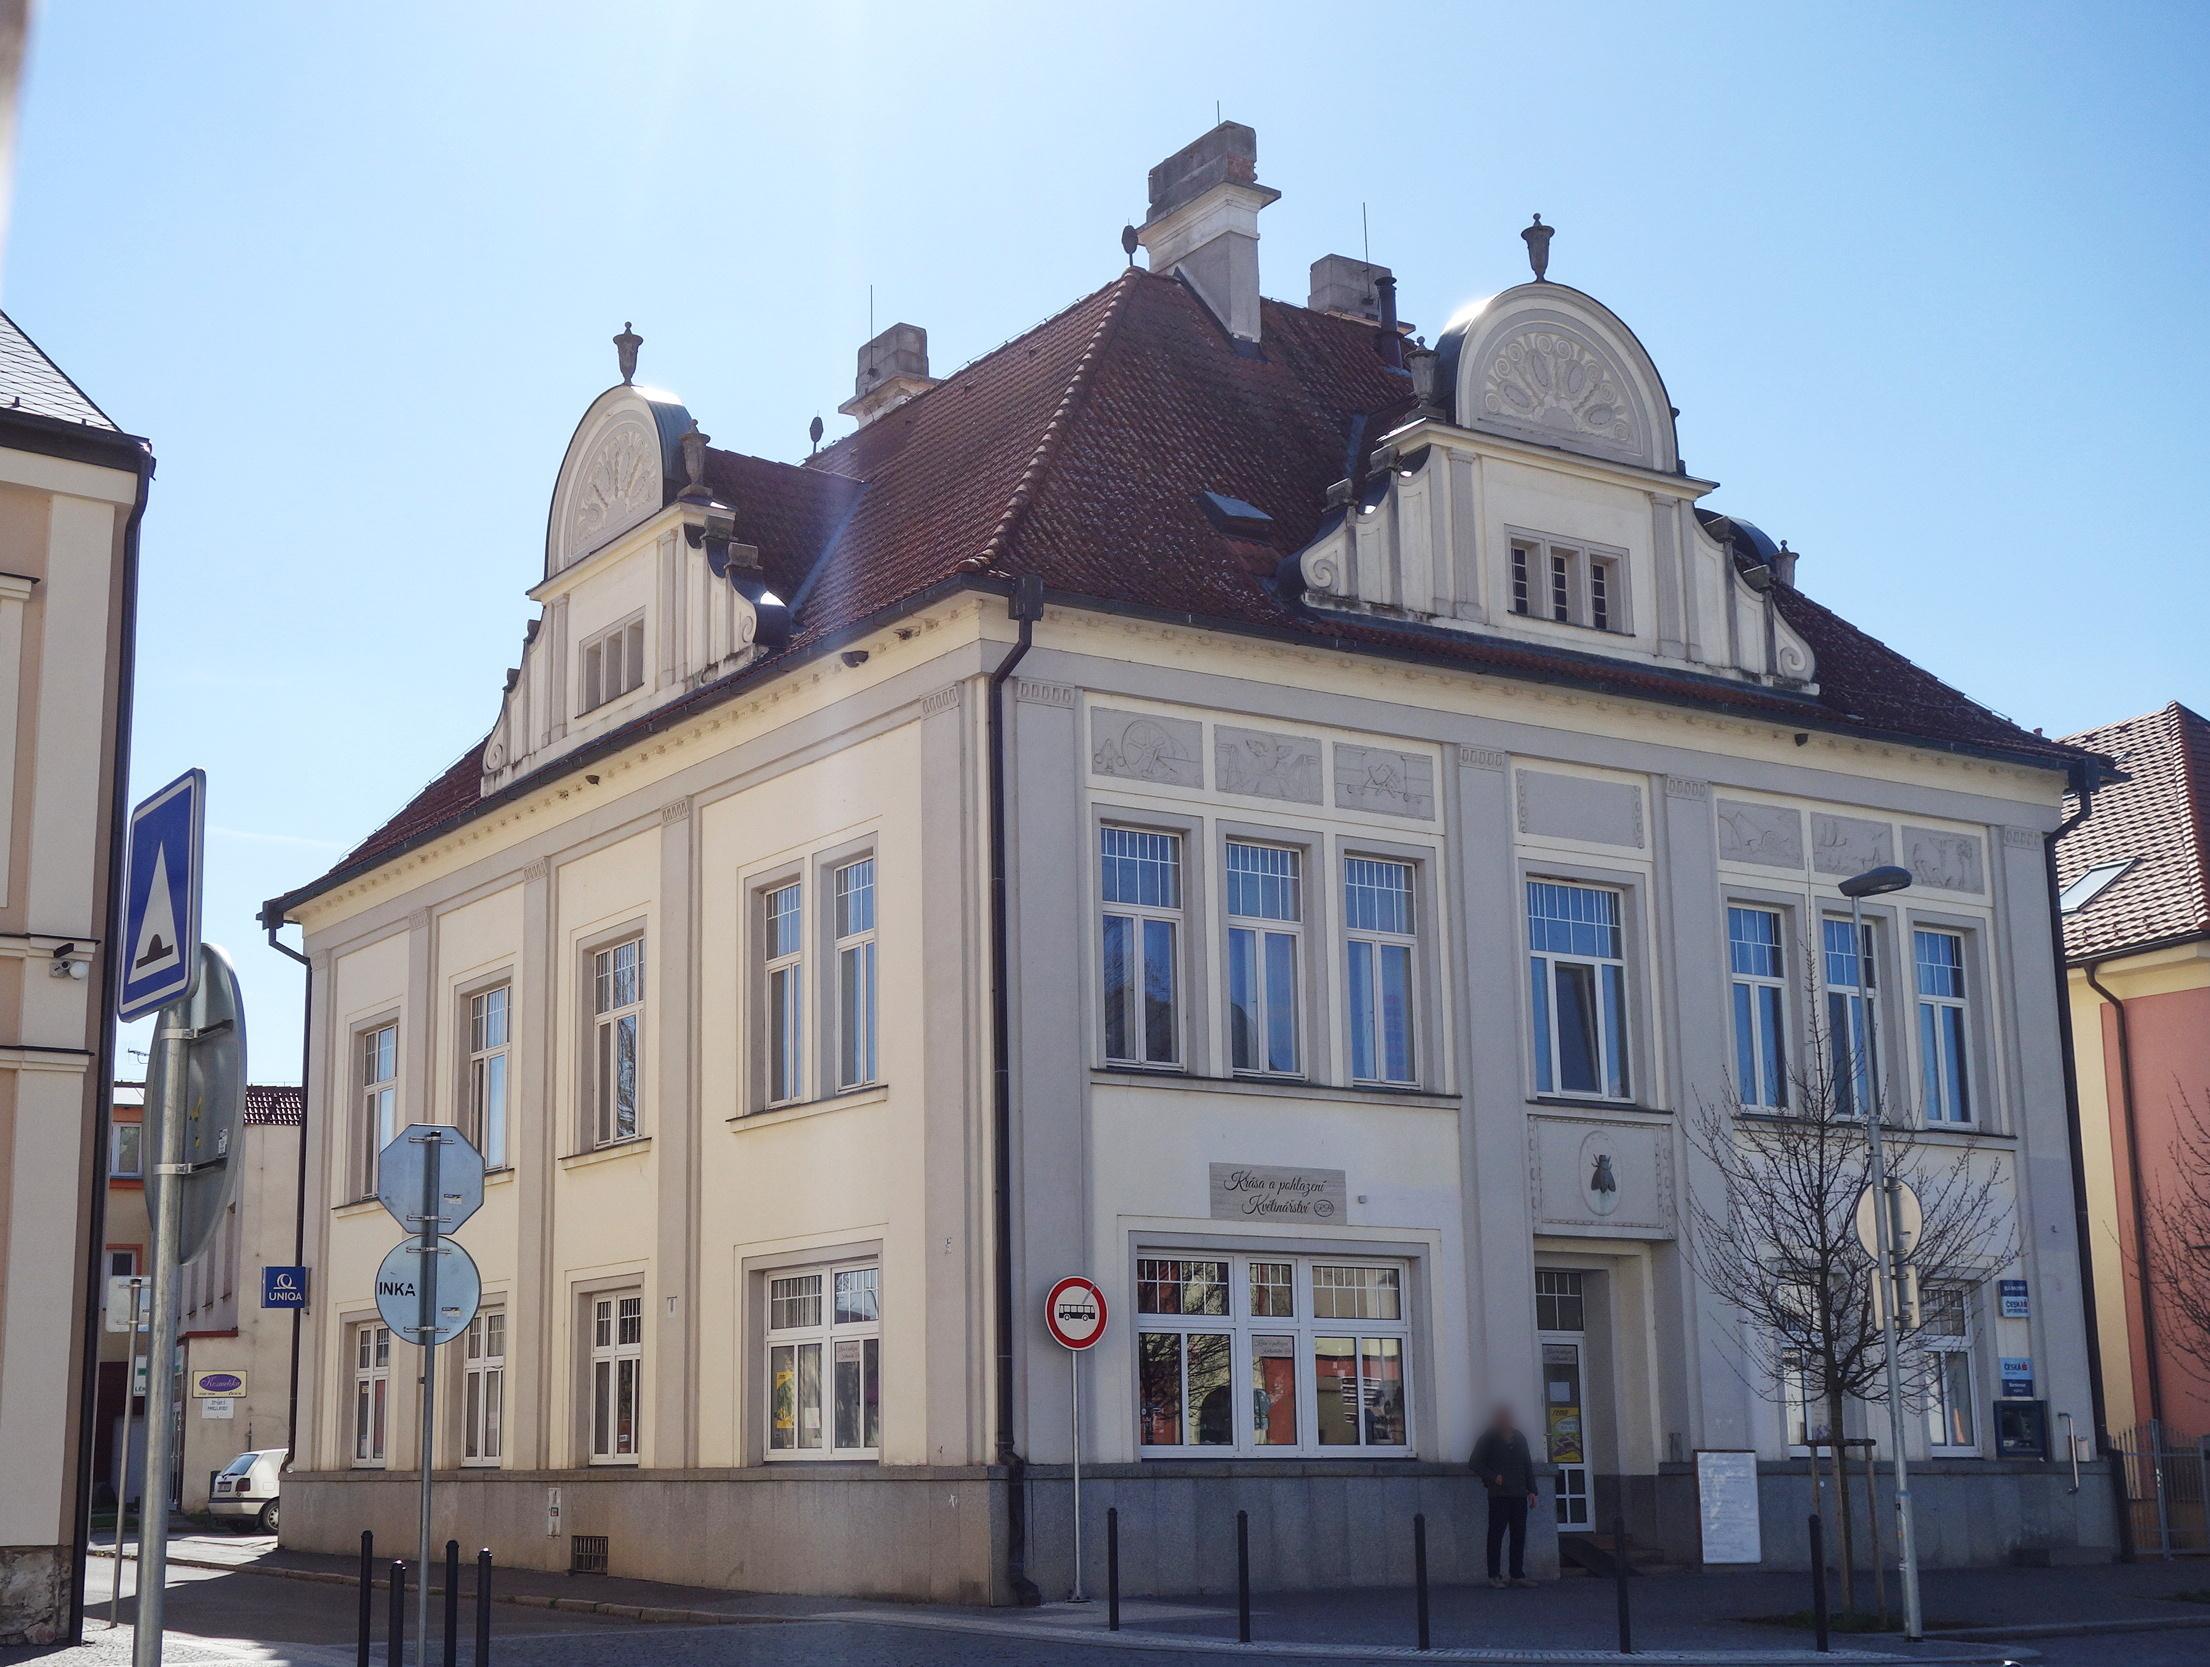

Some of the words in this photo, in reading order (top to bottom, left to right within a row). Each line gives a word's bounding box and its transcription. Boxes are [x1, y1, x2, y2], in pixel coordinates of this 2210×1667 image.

[1224, 1170, 1265, 1191] Krása
[1269, 1181, 1275, 1189] a
[1277, 1177, 1327, 1198] pohlazení
[379, 1282, 416, 1296] INKA
[268, 1292, 303, 1301] UNIQA
